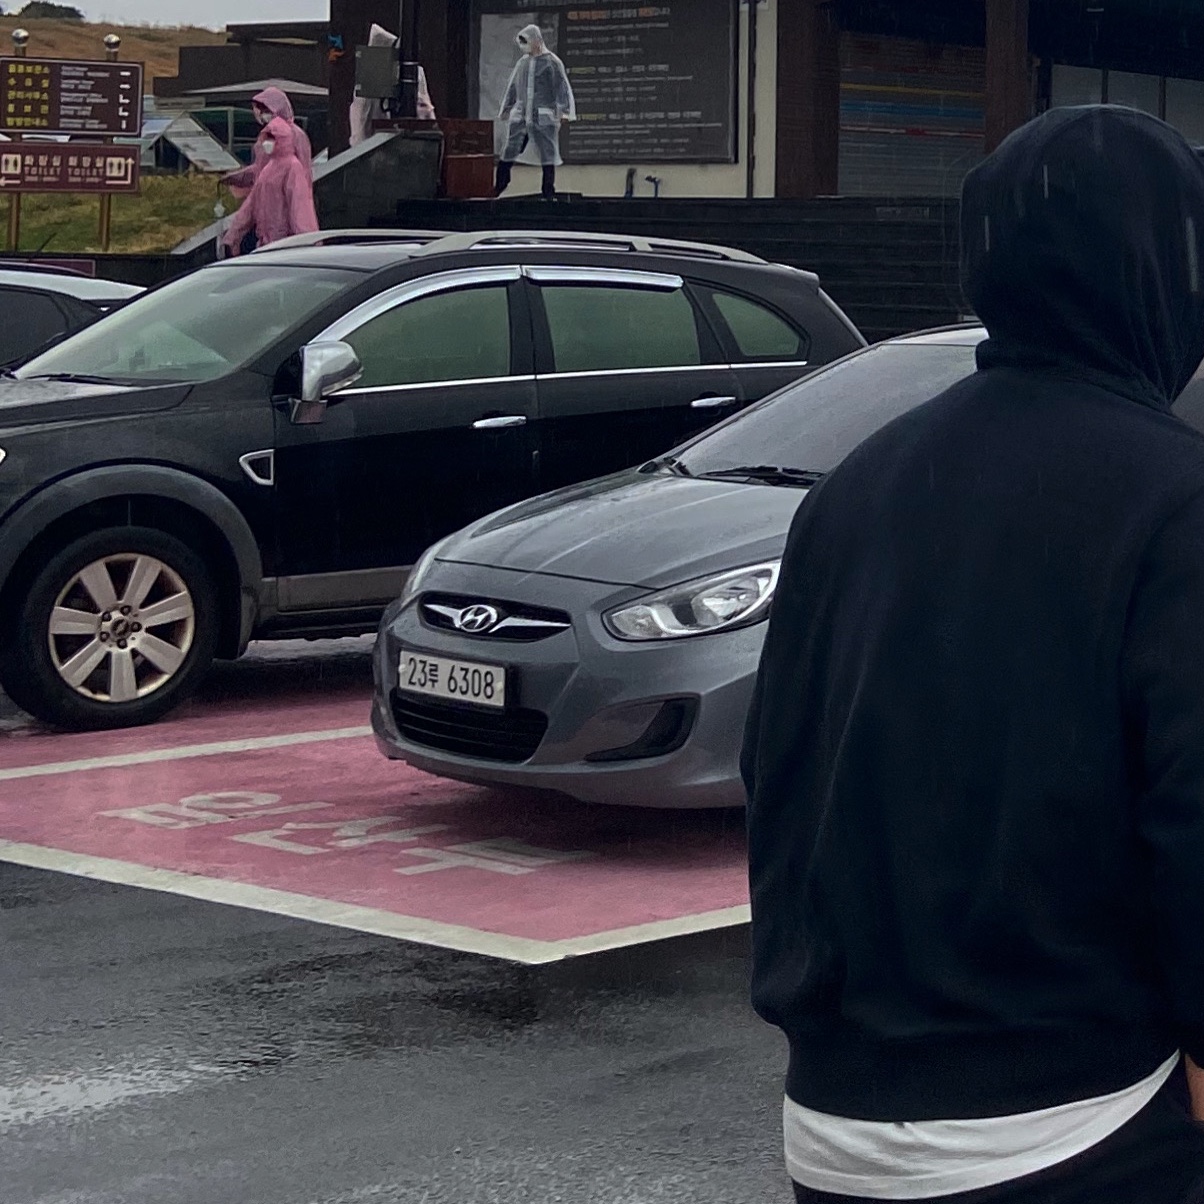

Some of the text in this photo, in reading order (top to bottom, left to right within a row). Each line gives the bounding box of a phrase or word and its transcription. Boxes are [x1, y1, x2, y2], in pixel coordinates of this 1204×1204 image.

[408, 657, 494, 699] 23루 6308
[100, 790, 603, 876] 임산부
